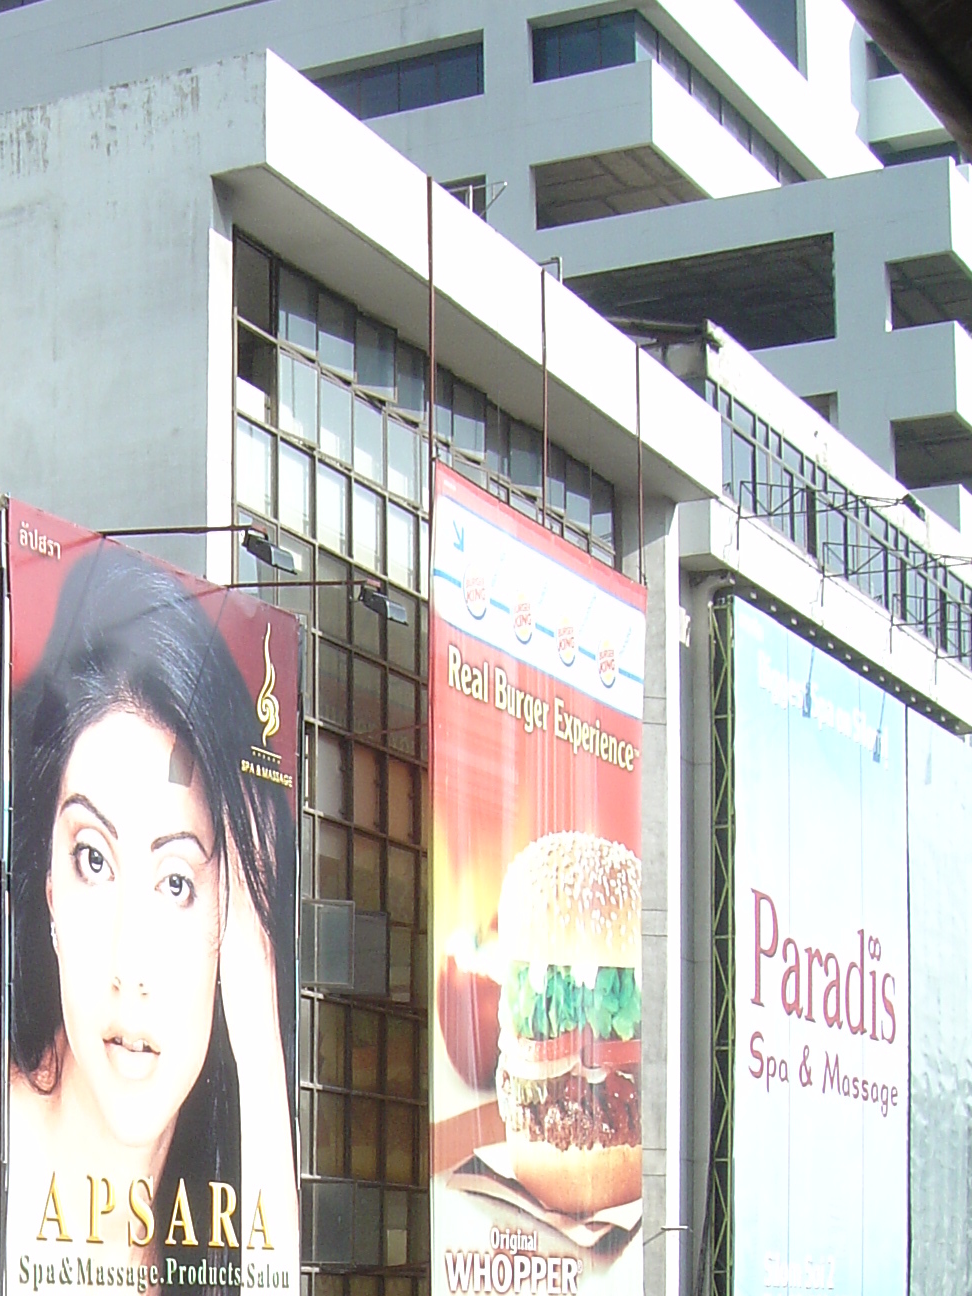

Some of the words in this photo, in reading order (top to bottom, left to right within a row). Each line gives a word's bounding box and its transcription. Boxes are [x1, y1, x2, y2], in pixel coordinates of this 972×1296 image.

[447, 644, 489, 703] Real
[493, 664, 550, 733] Burger
[241, 759, 255, 774] SPA
[262, 766, 293, 788] MASSAGE
[749, 887, 897, 1044] Paradis
[748, 1031, 789, 1093] Spa
[798, 1044, 813, 1088] &
[822, 1050, 898, 1117] Massage
[36, 1171, 275, 1250] APSARA
[489, 1227, 538, 1255] Original
